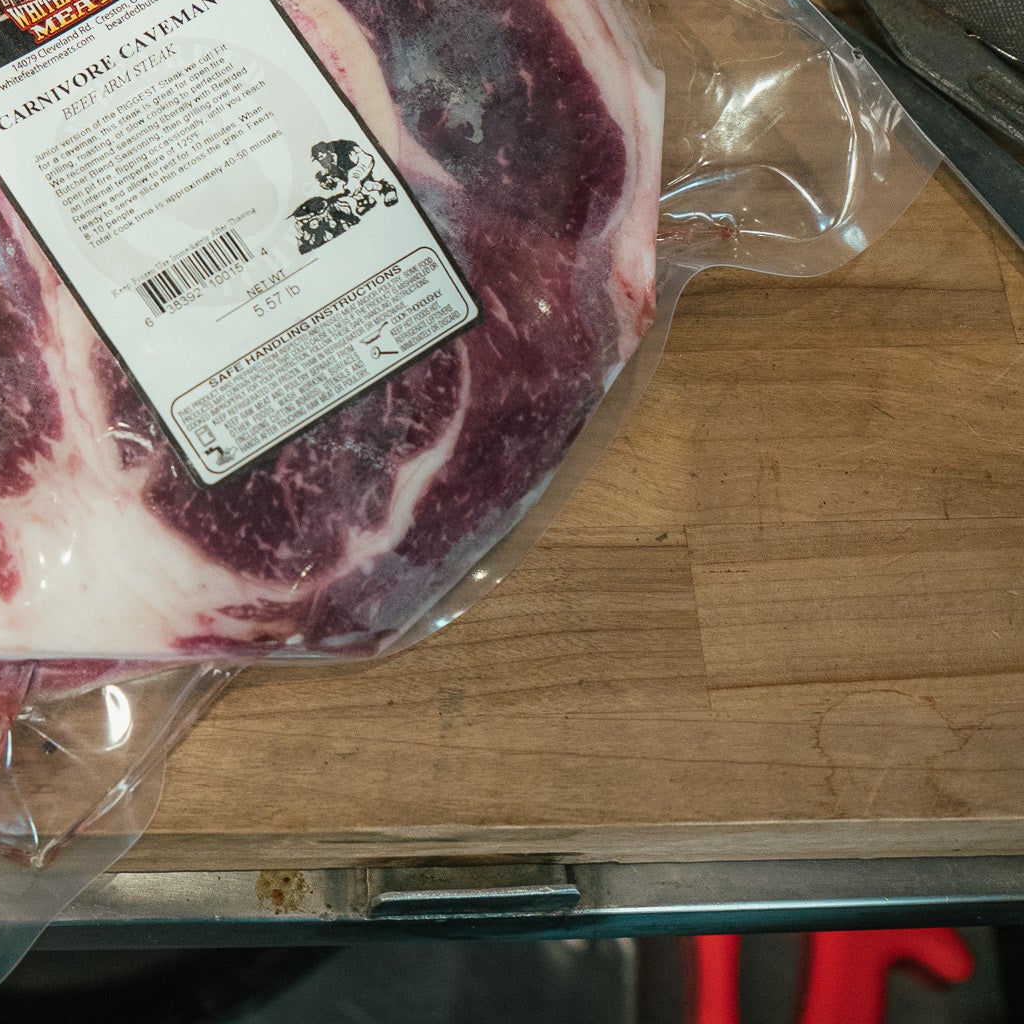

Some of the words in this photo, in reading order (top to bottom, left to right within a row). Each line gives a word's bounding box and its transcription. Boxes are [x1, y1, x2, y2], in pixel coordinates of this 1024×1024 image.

[0, 29, 96, 91] whitefeathermeats.com
[12, 54, 38, 72] 14079
[37, 30, 79, 58] Cleveland
[78, 22, 92, 35] Rd.
[95, 3, 131, 25] Creston,
[35, 145, 59, 163] Junior
[60, 127, 92, 148] version
[92, 120, 101, 130] of
[102, 112, 116, 123] the
[116, 85, 157, 114] BIGGEST
[158, 71, 184, 89] Steak
[184, 63, 197, 73] we
[213, 44, 228, 55] Fit
[38, 161, 51, 172] for
[100, 123, 117, 136] this
[118, 108, 141, 126] steak
[141, 103, 152, 111] is
[152, 87, 175, 106] great
[174, 80, 187, 90] for
[189, 66, 210, 82] open
[209, 57, 225, 69] fire
[62, 90, 97, 121] BEEF
[103, 70, 132, 98] ARM
[133, 42, 177, 77] STEAK
[115, 130, 124, 139] or
[125, 118, 145, 133] slow
[146, 97, 180, 120] cooking
[179, 91, 189, 100] to
[49, 177, 65, 188] We
[66, 147, 116, 180] recommend
[116, 121, 160, 151] seasoning
[159, 100, 193, 124] liberally
[193, 90, 211, 103] with
[210, 66, 248, 92] Bearded
[55, 176, 88, 198] Butcher
[88, 160, 115, 179] Blend
[162, 120, 182, 134] then
[183, 101, 212, 123] grilling
[212, 90, 230, 104] over
[232, 83, 243, 92] an
[62, 191, 84, 207] open
[84, 183, 97, 195] pit
[115, 153, 148, 175] flipping
[207, 104, 226, 119] until
[225, 96, 242, 109] you
[242, 80, 266, 98] reach
[72, 201, 108, 224] Remove
[109, 190, 126, 203] and
[127, 177, 148, 193] allow
[148, 170, 159, 179] to
[159, 158, 177, 173] rest
[176, 151, 189, 161] for
[191, 142, 203, 152] 10
[238, 106, 263, 123] When
[70, 204, 82, 214] an
[81, 184, 114, 207] internal
[114, 154, 165, 188] temperature
[166, 146, 175, 156] of
[78, 215, 103, 232] ready
[103, 209, 114, 218] to
[114, 195, 138, 210] serve
[139, 181, 160, 196] slice
[160, 171, 177, 184] thin
[178, 154, 207, 173] across
[206, 144, 221, 155] the
[246, 111, 274, 130] Feeds
[89, 232, 112, 248] Total
[113, 220, 135, 236] cook
[134, 208, 154, 223] time
[154, 202, 165, 210] is
[165, 166, 223, 204] approximately
[105, 208, 135, 230] people
[144, 317, 154, 328] 6
[166, 287, 204, 315] 38392
[209, 262, 244, 288] 10015
[261, 247, 268, 256] 4
[246, 280, 268, 298] NET
[268, 269, 286, 284] WT
[284, 285, 301, 298] lb
[209, 362, 242, 388] SAFE
[245, 322, 311, 365] HANDLING
[311, 262, 402, 325] INSTRUCTIONS
